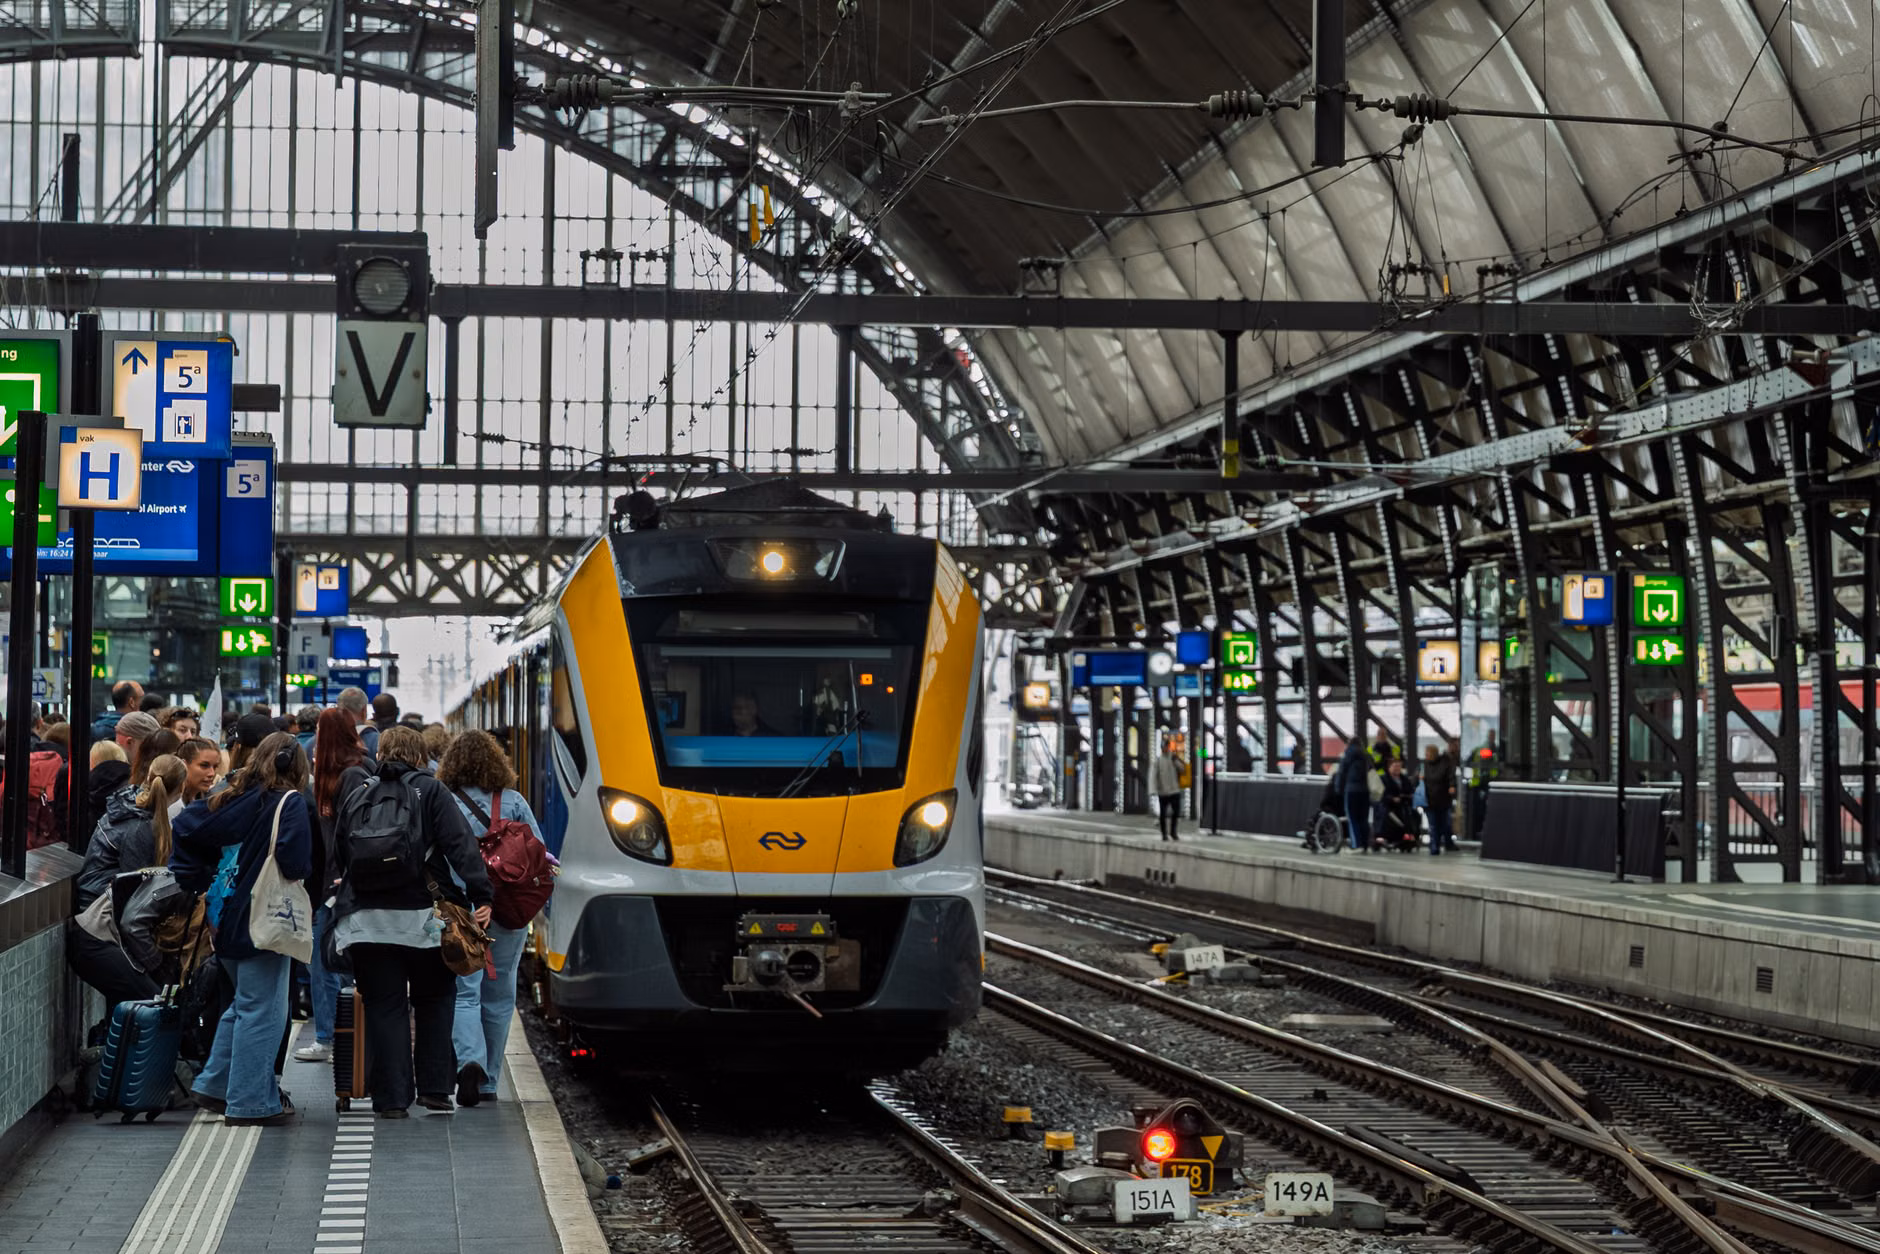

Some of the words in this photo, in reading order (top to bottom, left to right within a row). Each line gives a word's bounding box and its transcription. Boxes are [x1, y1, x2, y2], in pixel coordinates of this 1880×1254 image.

[346, 330, 416, 416] V
[80, 434, 95, 443] vak
[141, 461, 164, 471] nter
[79, 451, 120, 500] H
[146, 504, 177, 515] Airport
[50, 549, 69, 557] 16:24
[1273, 1181, 1329, 1202] 149A
[1130, 1189, 1176, 1211] 151A
